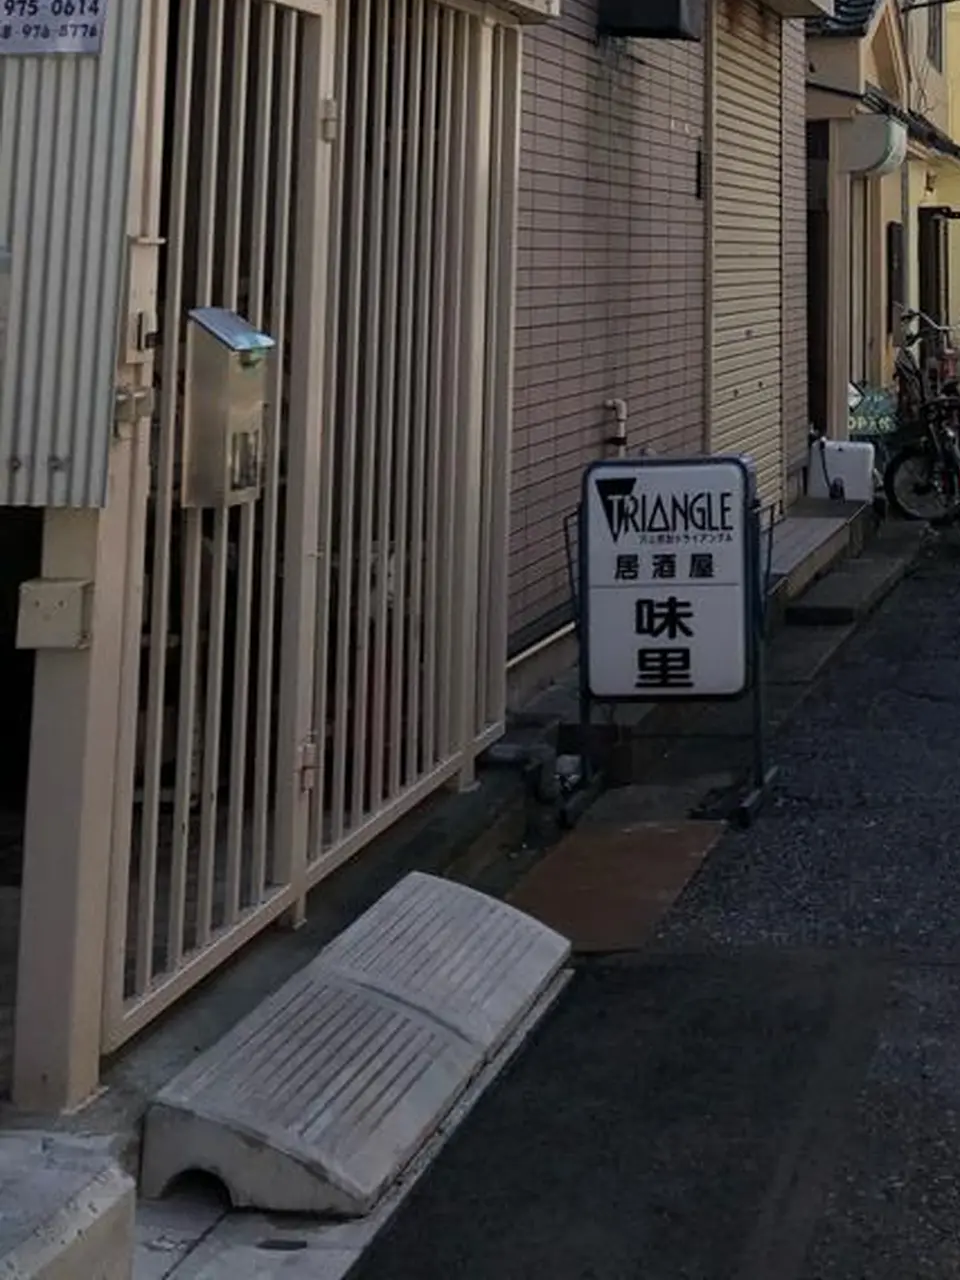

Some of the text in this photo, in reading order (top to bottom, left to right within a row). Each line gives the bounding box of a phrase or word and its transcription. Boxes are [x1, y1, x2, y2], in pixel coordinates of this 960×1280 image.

[604, 491, 734, 536] TRIANGLE
[615, 553, 715, 580] 居酒屋
[634, 595, 695, 689] 味里
